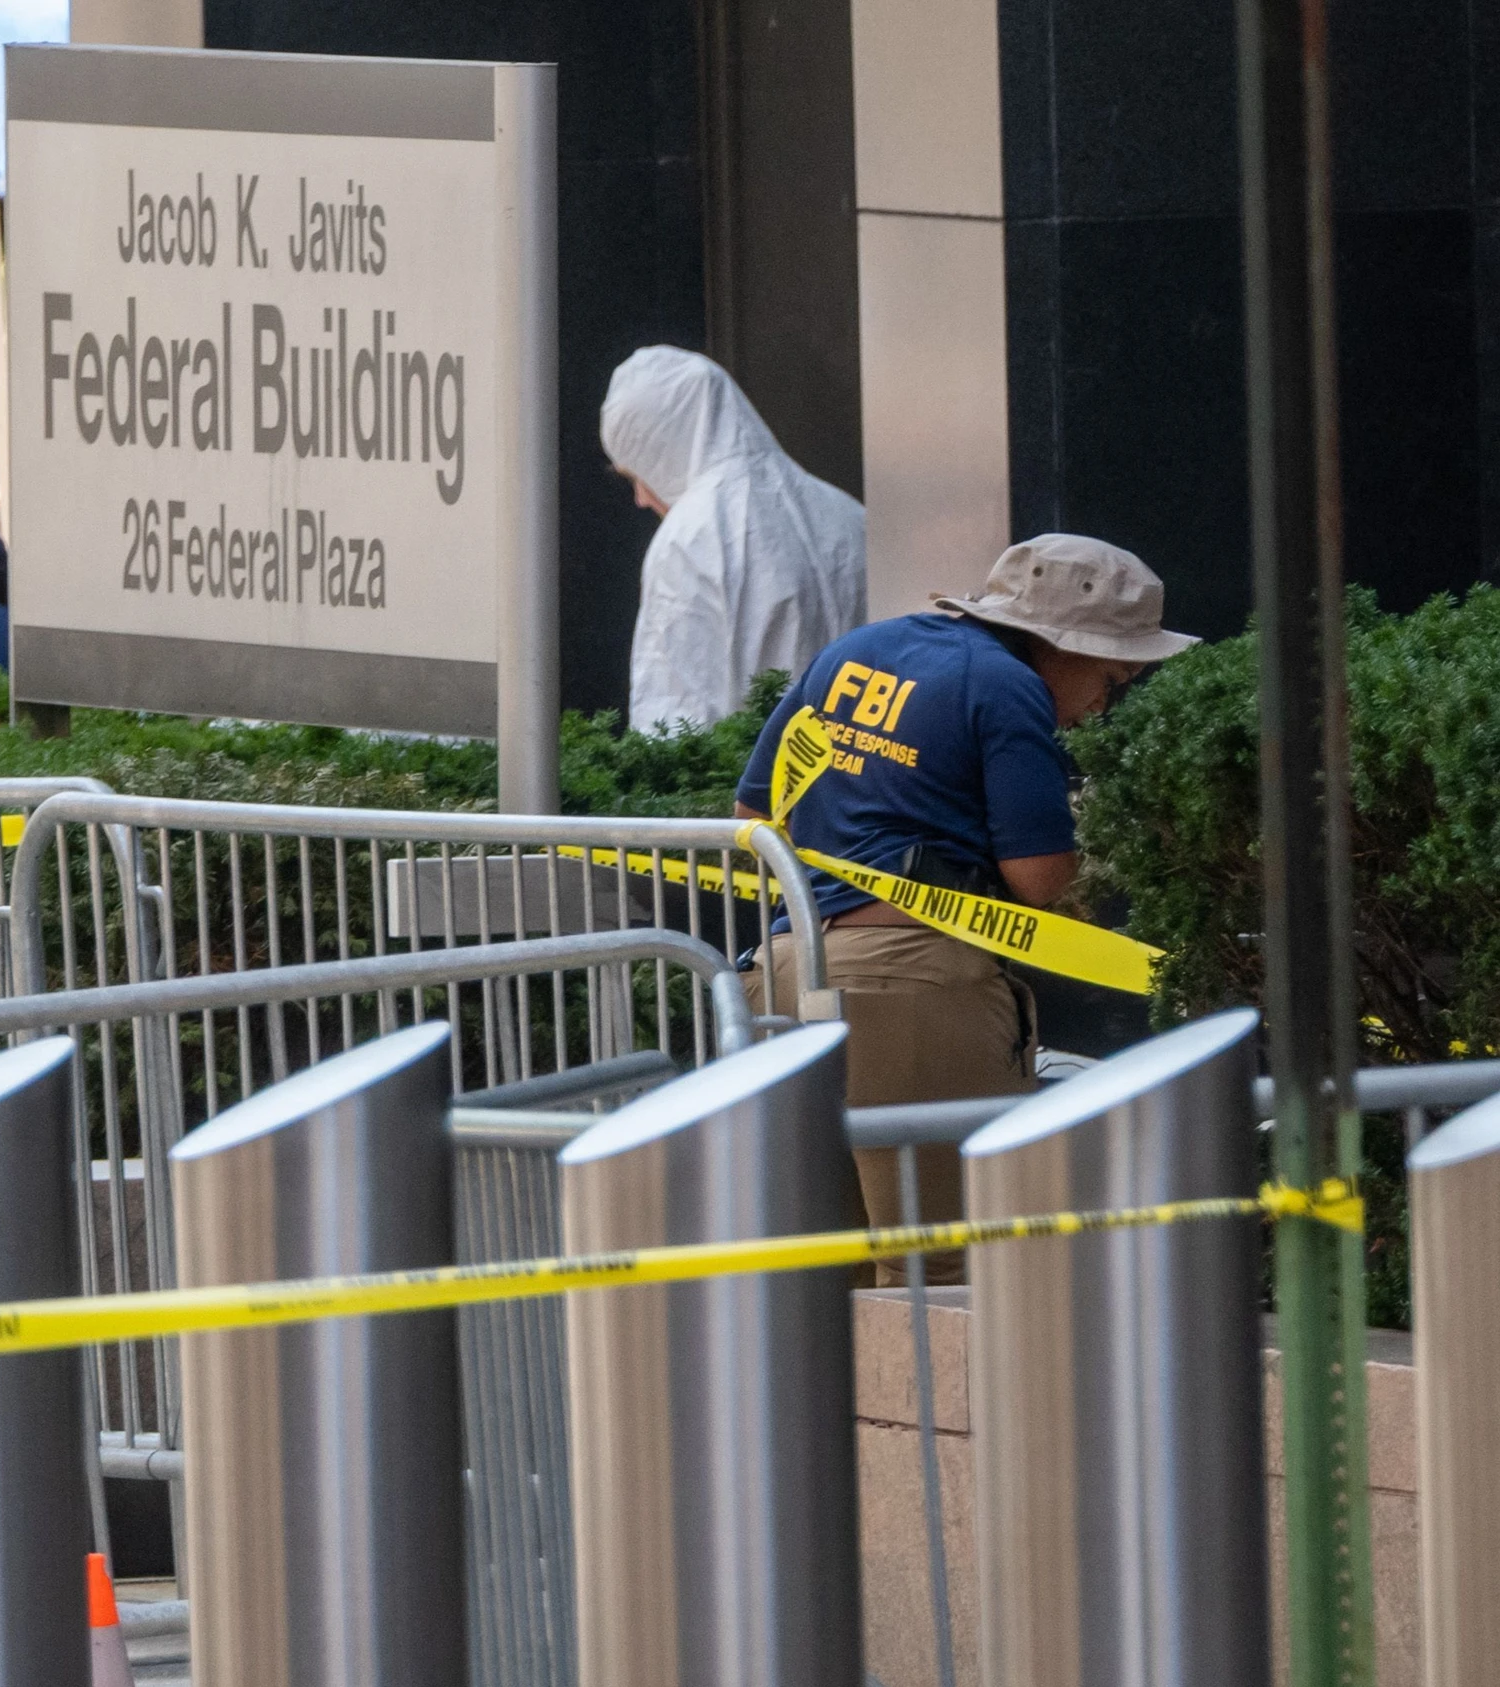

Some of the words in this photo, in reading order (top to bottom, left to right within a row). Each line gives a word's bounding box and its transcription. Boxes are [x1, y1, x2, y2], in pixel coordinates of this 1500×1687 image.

[117, 169, 216, 267] Jacob
[237, 174, 268, 269] K.
[288, 177, 387, 275] Javits
[43, 291, 232, 452] Federal
[252, 303, 465, 506] Building
[122, 497, 162, 593] 26
[167, 500, 289, 603] Federal
[296, 508, 387, 609] Plaza
[823, 660, 917, 732] FBI
[787, 727, 827, 768] DO
[889, 879, 921, 910] DO
[921, 888, 968, 926] NOT
[968, 901, 1039, 953] ENTER
